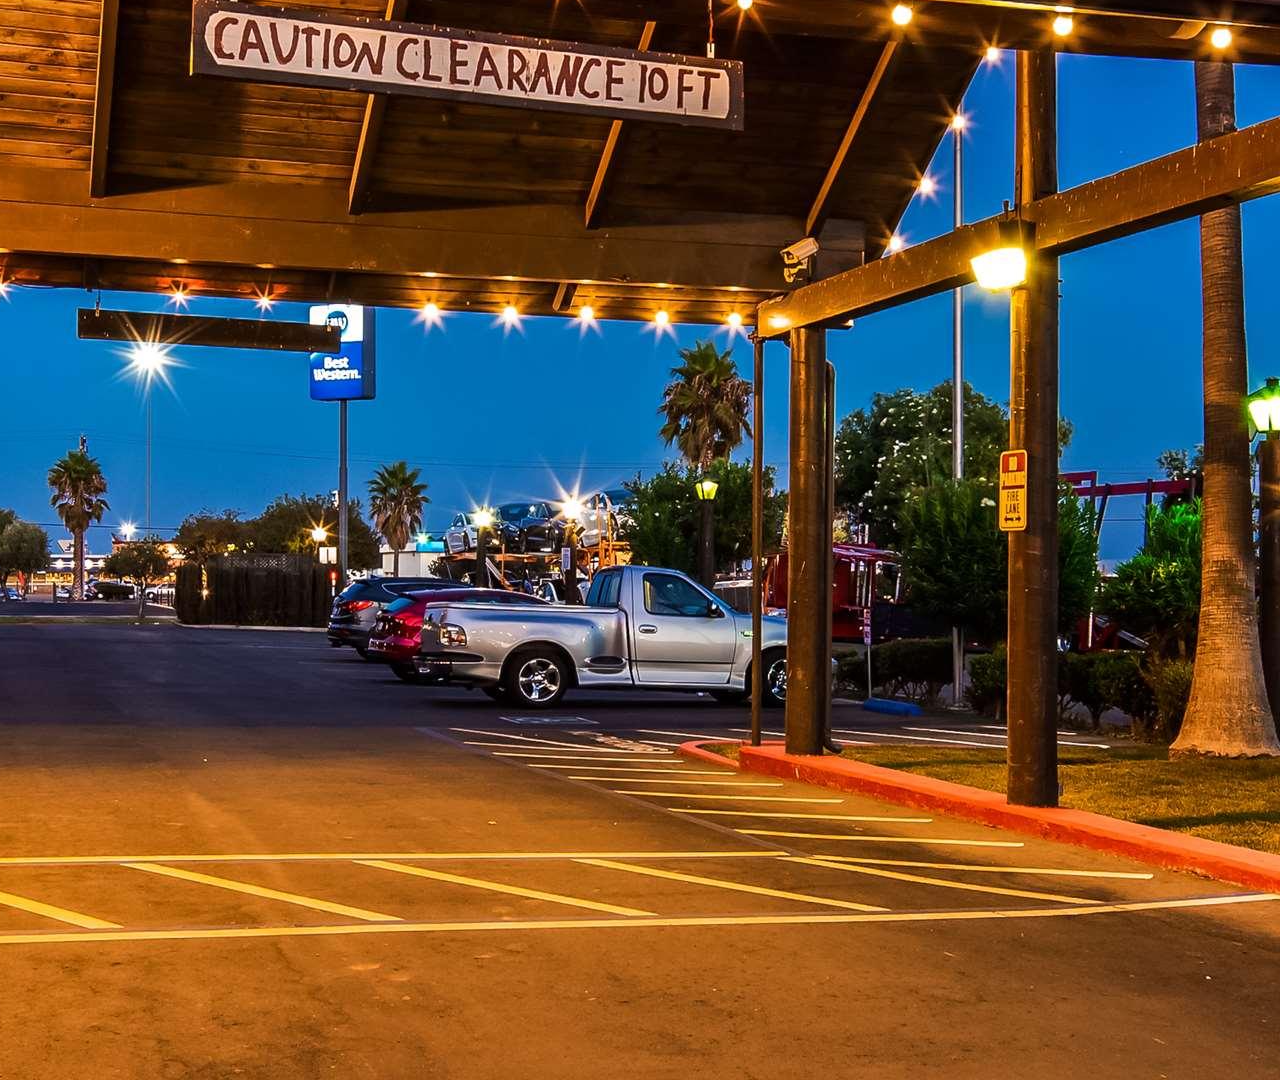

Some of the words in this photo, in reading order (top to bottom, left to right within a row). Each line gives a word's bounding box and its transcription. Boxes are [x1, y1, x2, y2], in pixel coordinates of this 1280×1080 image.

[213, 15, 388, 76] CAUTION
[396, 36, 625, 104] CLEARANCE
[677, 67, 720, 111] FT
[323, 356, 350, 369] Best
[1006, 490, 1020, 503] FIRE
[1005, 503, 1021, 515] LANE
